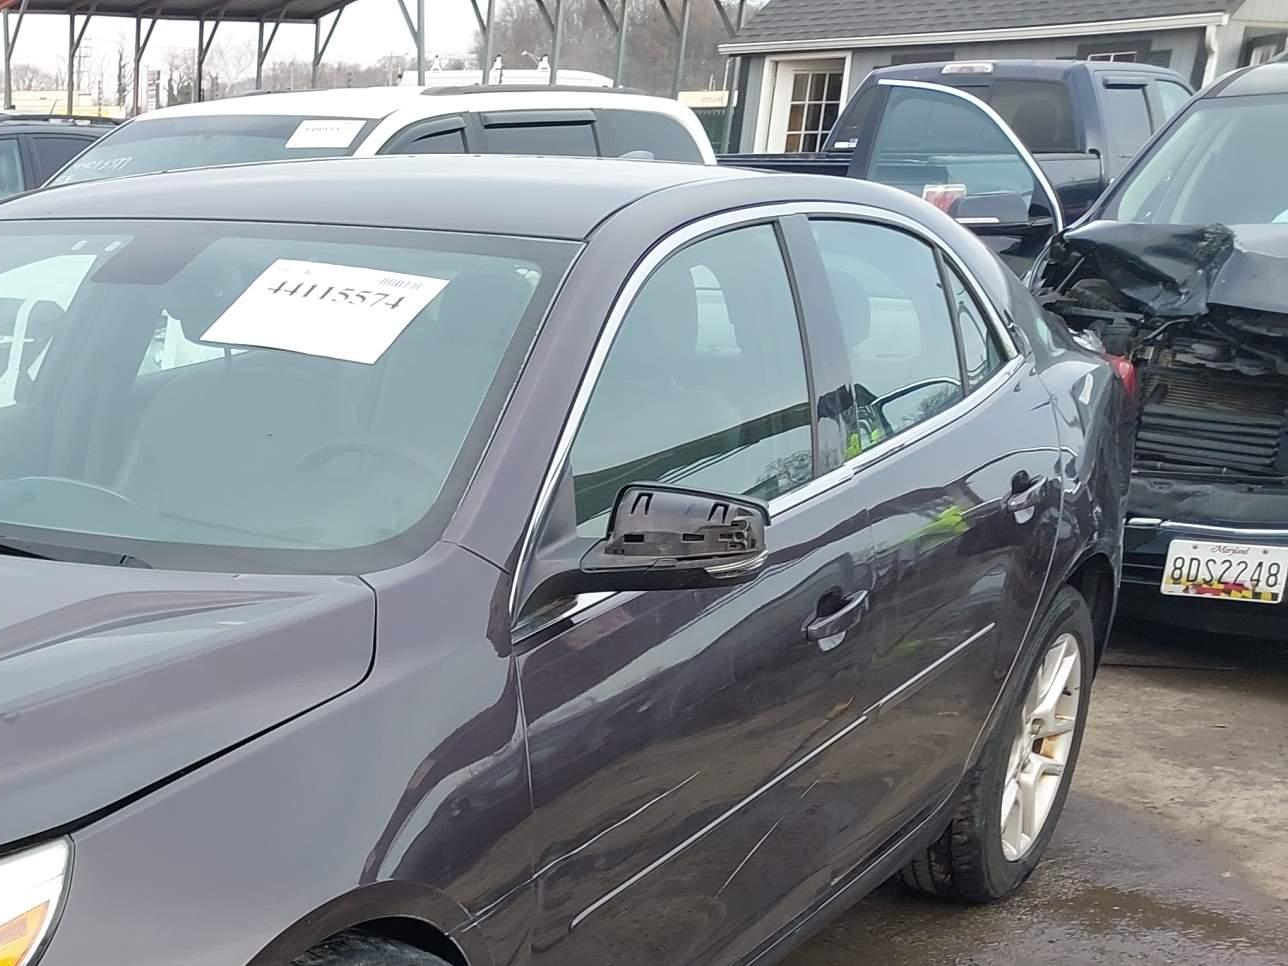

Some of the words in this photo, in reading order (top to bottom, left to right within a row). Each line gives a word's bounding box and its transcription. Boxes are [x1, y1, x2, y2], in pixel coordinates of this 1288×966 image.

[267, 280, 406, 310] 44115574
[1211, 545, 1251, 557] Maryland
[1170, 556, 1281, 588] 8DS2248
